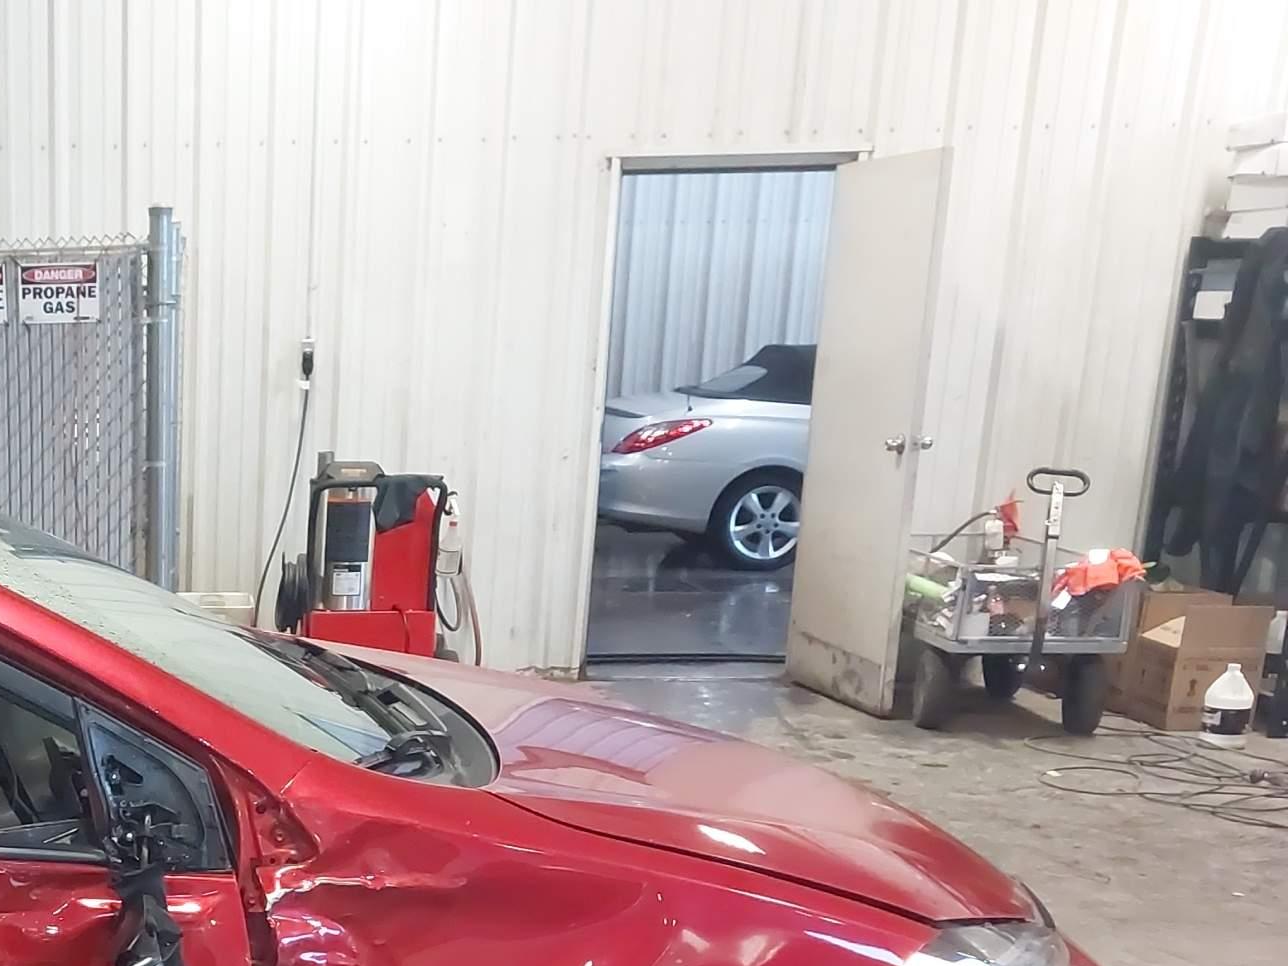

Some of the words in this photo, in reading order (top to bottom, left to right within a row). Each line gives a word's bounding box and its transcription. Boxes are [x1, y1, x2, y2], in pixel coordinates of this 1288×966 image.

[34, 269, 83, 281] DANGER
[21, 285, 97, 300] PROPANE
[43, 301, 76, 314] GAS
